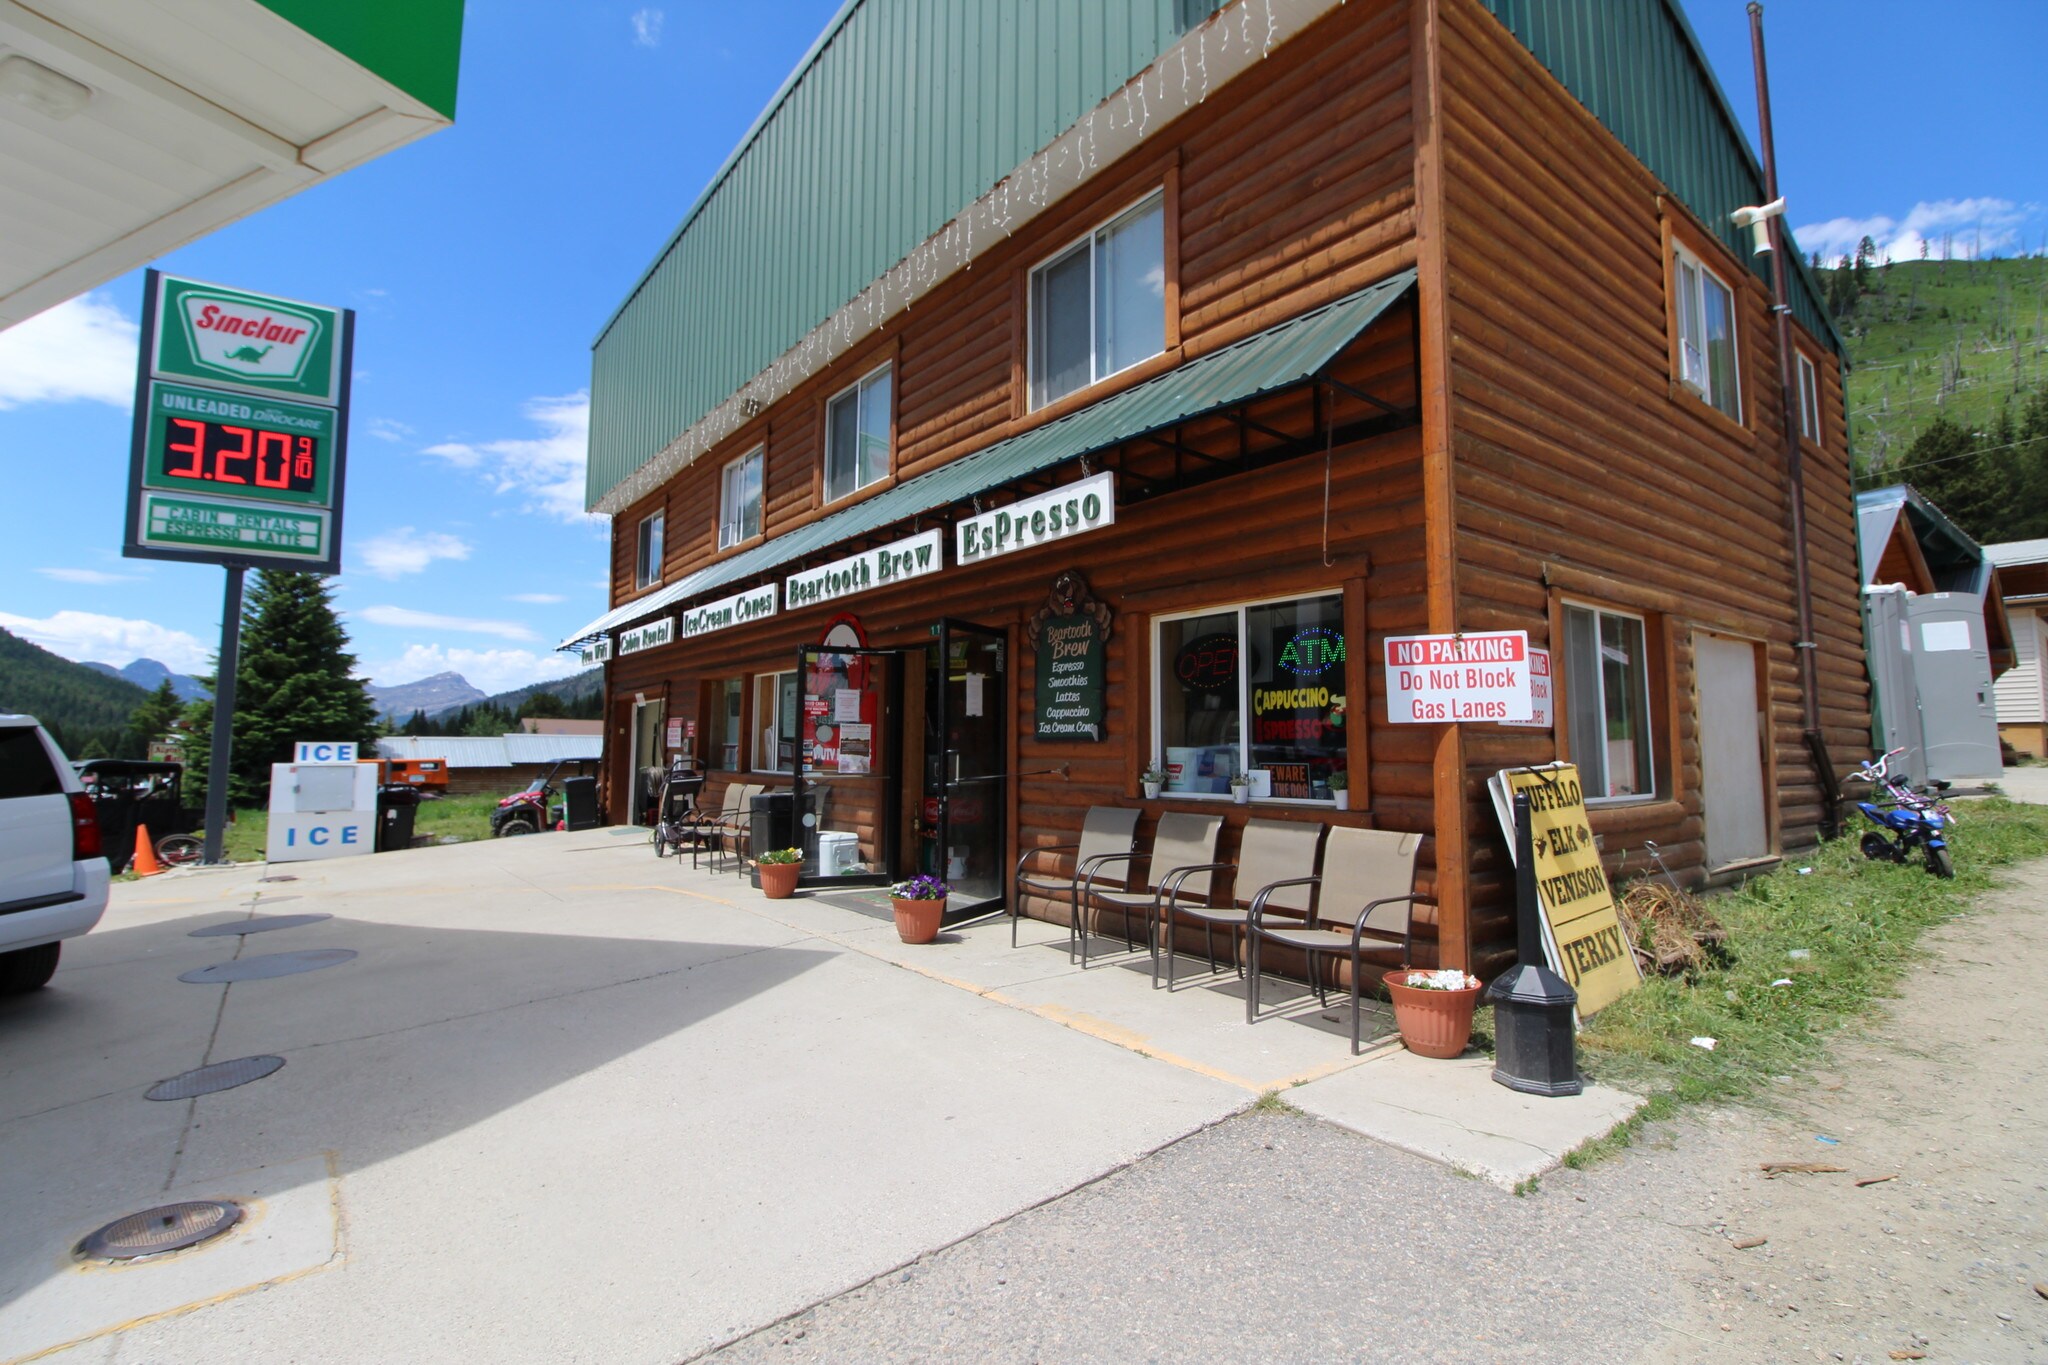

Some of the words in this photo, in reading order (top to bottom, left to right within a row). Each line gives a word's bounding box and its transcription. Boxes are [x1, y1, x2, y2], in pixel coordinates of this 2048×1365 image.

[196, 303, 306, 345] Sinclair
[162, 393, 252, 420] UNLEADED
[252, 410, 323, 431] DINOCARE
[168, 418, 292, 489] 3.20
[169, 506, 218, 525] CABIN
[235, 514, 301, 533] RENTALS
[166, 523, 241, 541] ESPRESSO
[254, 530, 302, 547] LATTE
[788, 556, 871, 604] Beartooth
[877, 543, 933, 580] Brew
[735, 592, 772, 619] Cones
[620, 633, 641, 652] Cabin
[642, 622, 669, 647] Rental
[1047, 620, 1092, 643] Beartooth
[1052, 639, 1090, 660] Brew
[1277, 636, 1347, 667] ATM
[1397, 641, 1424, 664] NO
[1429, 638, 1513, 664] PARKING
[1051, 661, 1085, 673] Espresso
[1400, 670, 1423, 691] Do
[1430, 669, 1460, 690] Not
[1466, 667, 1516, 689] Block
[1048, 674, 1089, 689] Smoothies
[1055, 691, 1081, 703] Lattes
[1254, 686, 1329, 716] CAPPUCCINO
[1411, 698, 1446, 720] Gas
[1452, 698, 1507, 719] Lanes
[1046, 705, 1090, 720] Cappuccino
[1038, 722, 1051, 733] Ice
[1052, 722, 1076, 733] Cream
[300, 744, 352, 762] ICE
[1274, 782, 1289, 798] THE
[1290, 782, 1308, 798] DOG
[287, 826, 359, 847] ICE
[1547, 823, 1578, 856] ELK
[1540, 865, 1606, 908] VENISON
[1563, 924, 1626, 988] JERKY
